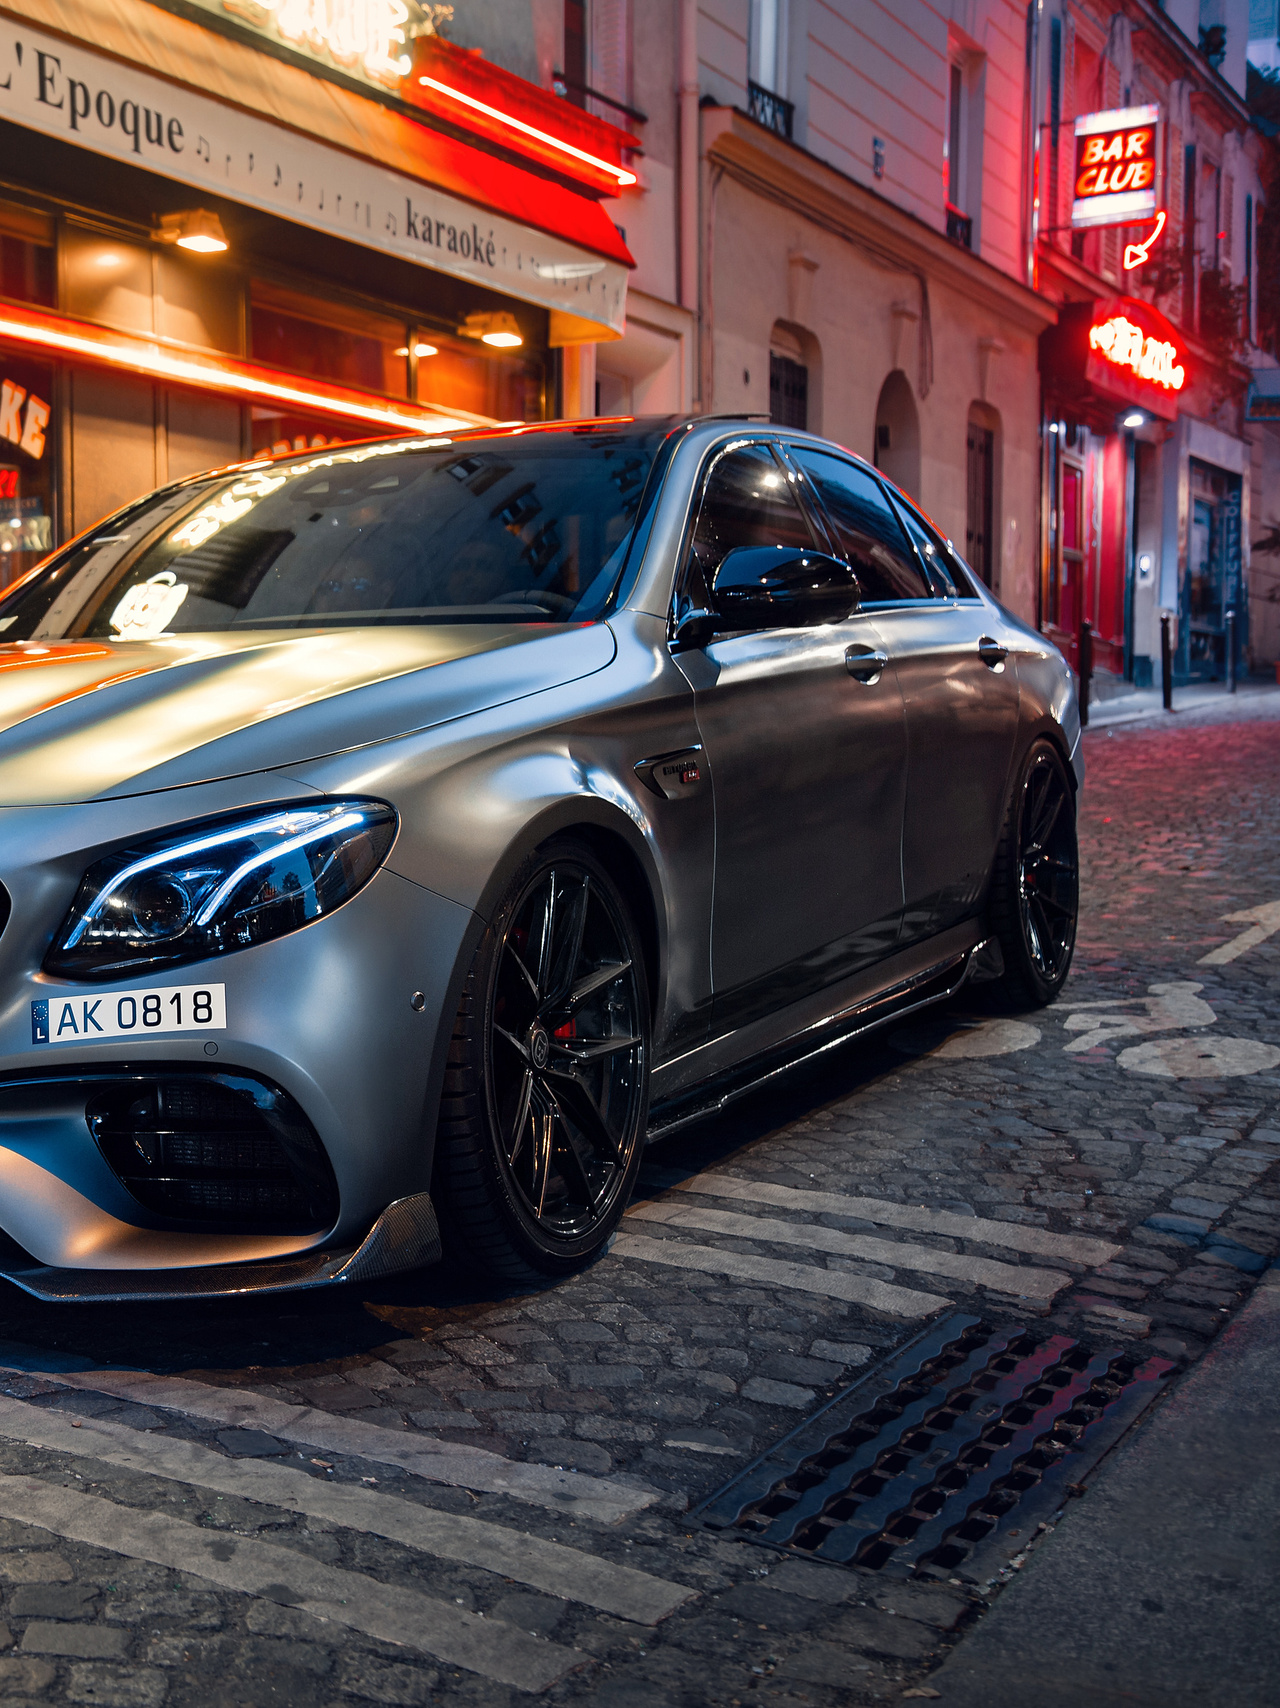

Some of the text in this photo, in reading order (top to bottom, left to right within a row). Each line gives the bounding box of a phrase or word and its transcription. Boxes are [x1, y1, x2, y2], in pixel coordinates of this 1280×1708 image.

[1082, 126, 1152, 168] BAR
[1075, 158, 1156, 196] CLUB
[405, 197, 497, 268] karaoké
[36, 1027, 46, 1040] L
[56, 989, 213, 1037] AK 0818
